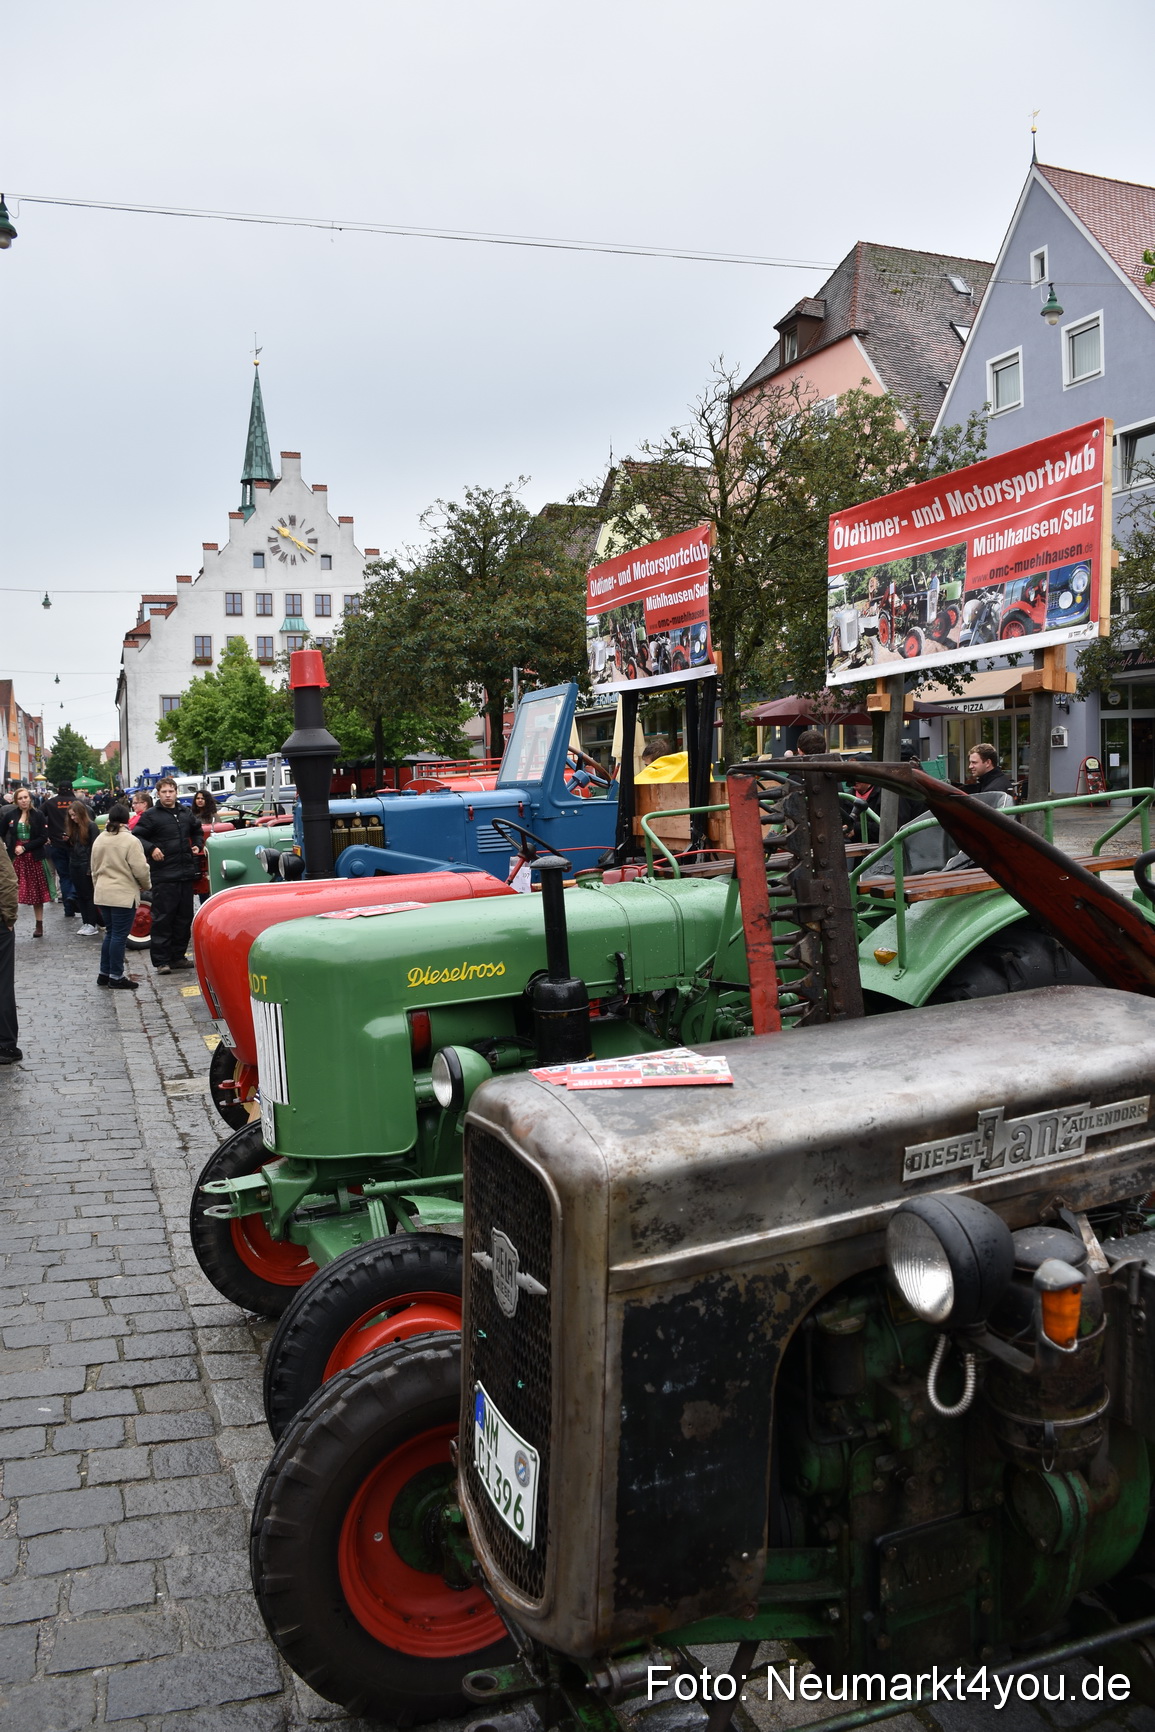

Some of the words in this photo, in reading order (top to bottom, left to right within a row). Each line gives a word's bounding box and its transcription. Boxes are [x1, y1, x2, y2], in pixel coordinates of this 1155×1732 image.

[833, 516, 908, 551] Oldtimer-
[911, 496, 945, 529] und
[945, 443, 1096, 518] Motorsportclub
[973, 503, 1095, 558] Mühlhausen/Sulz
[590, 575, 617, 597] Oldtimer-
[617, 565, 632, 587] und
[632, 540, 708, 581] Motorsportclub
[971, 543, 1093, 584] www.omc-muehlhausen.de
[646, 581, 708, 611] Mühlhausen/Sulz
[963, 703, 984, 712] PIZZA
[407, 961, 506, 988] Dieselross
[909, 1138, 986, 1173] DIESEL
[1067, 1103, 1146, 1133] AULENDORF
[483, 1403, 499, 1458] NM
[493, 1464, 525, 1532] 396
